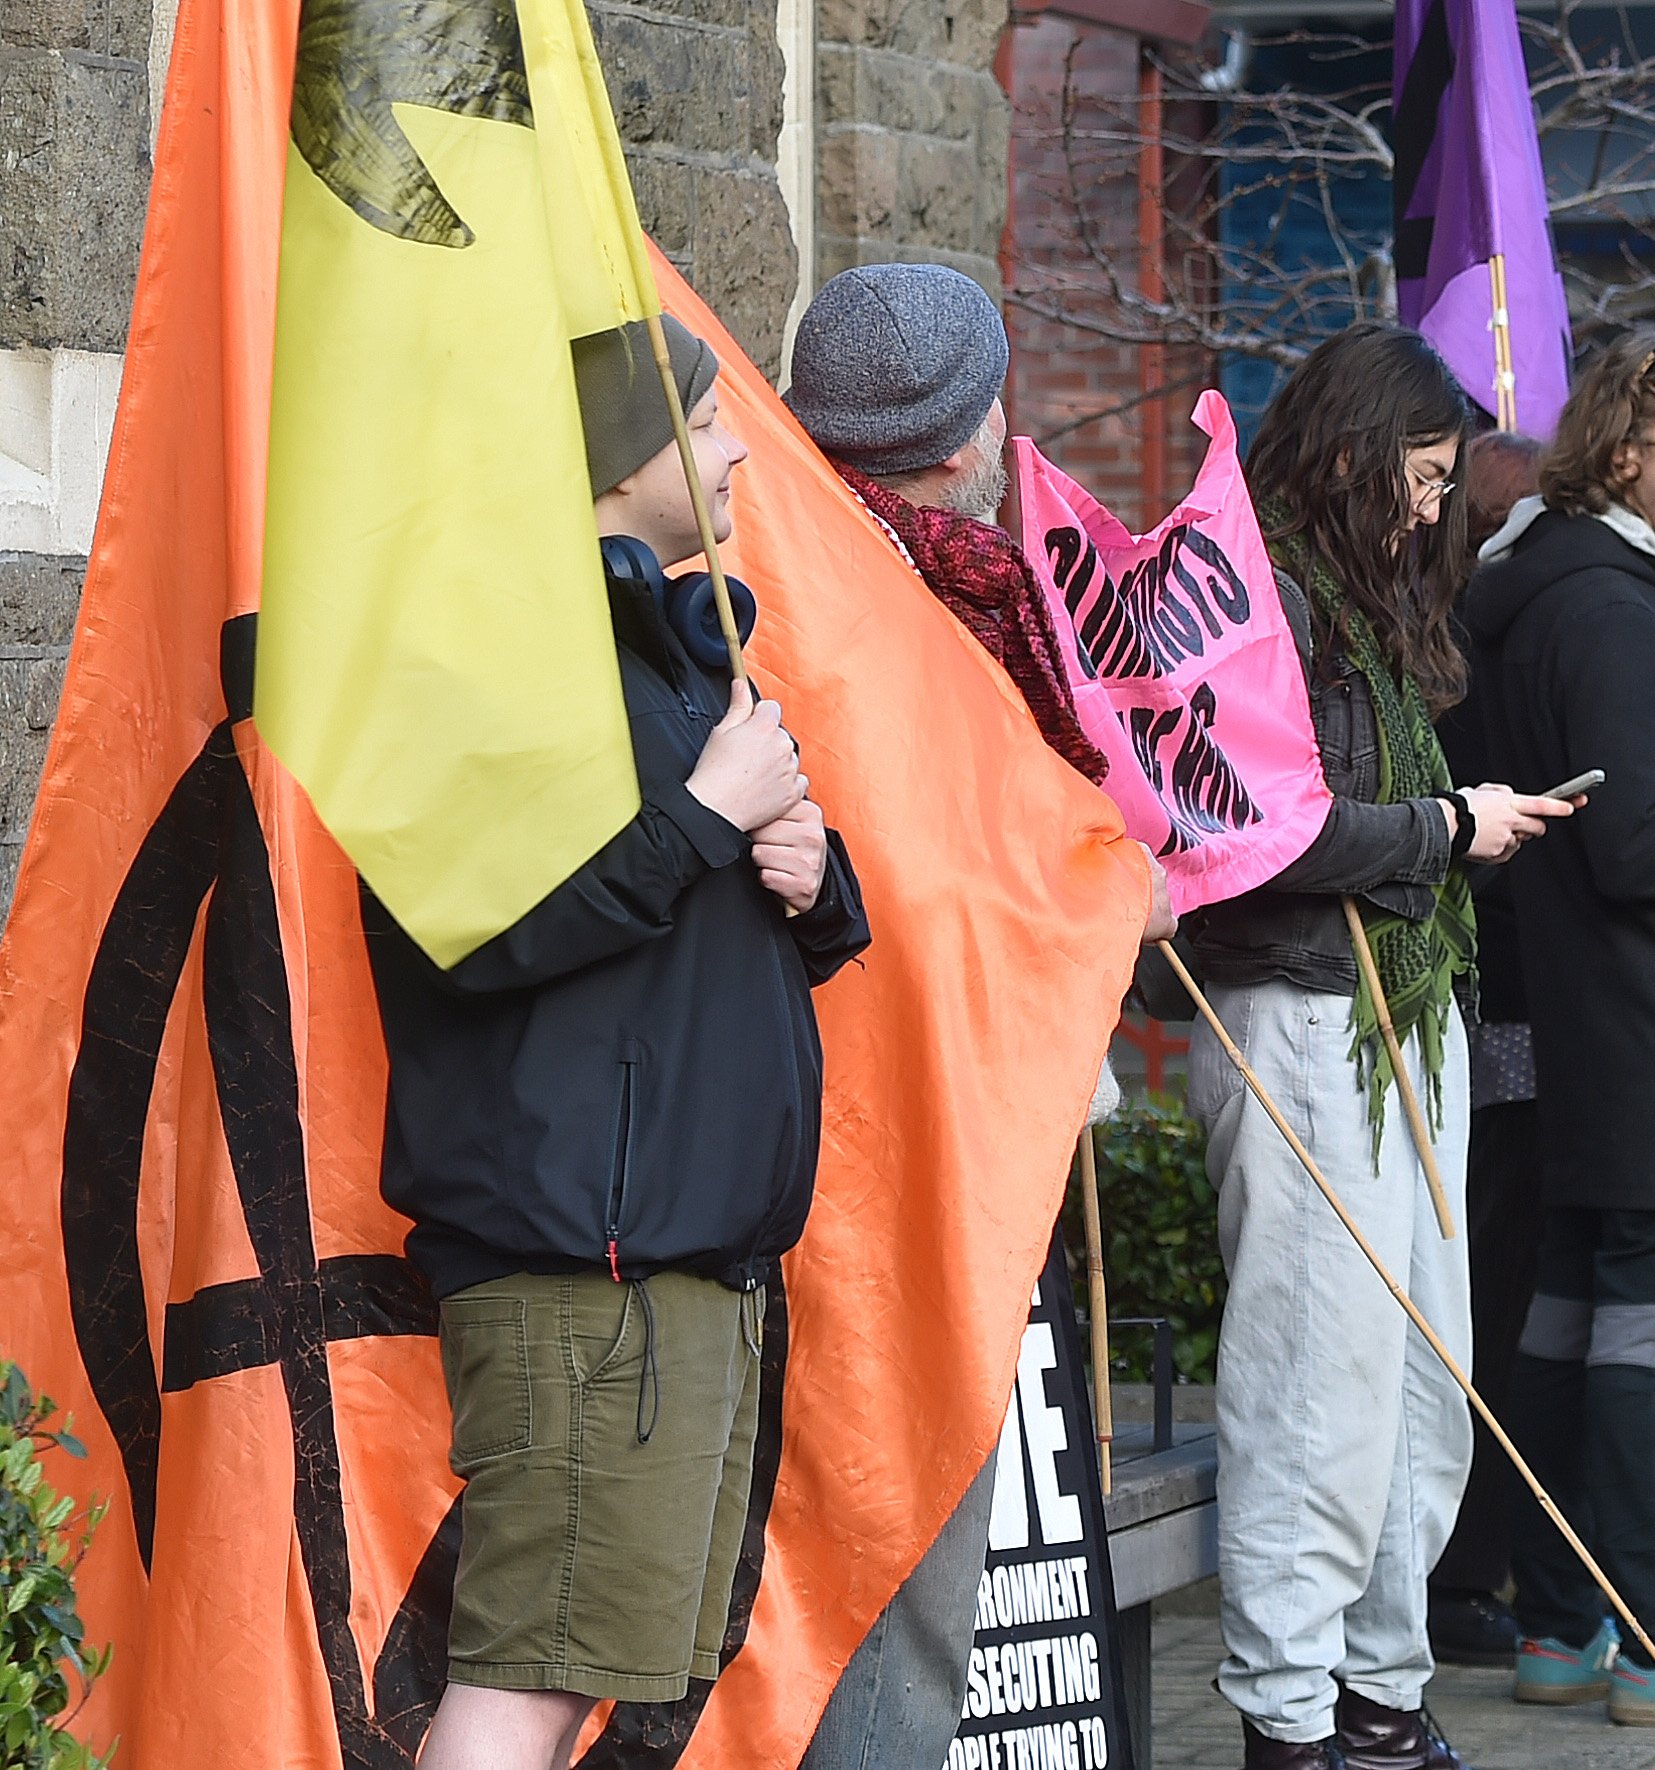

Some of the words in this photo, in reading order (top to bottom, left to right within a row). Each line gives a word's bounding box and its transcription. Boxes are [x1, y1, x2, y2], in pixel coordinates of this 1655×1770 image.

[961, 1632, 1101, 1719] SECUTING
[942, 1732, 1003, 1770] OPLE
[1001, 1720, 1080, 1770] TRYING
[1078, 1715, 1108, 1770] TO
